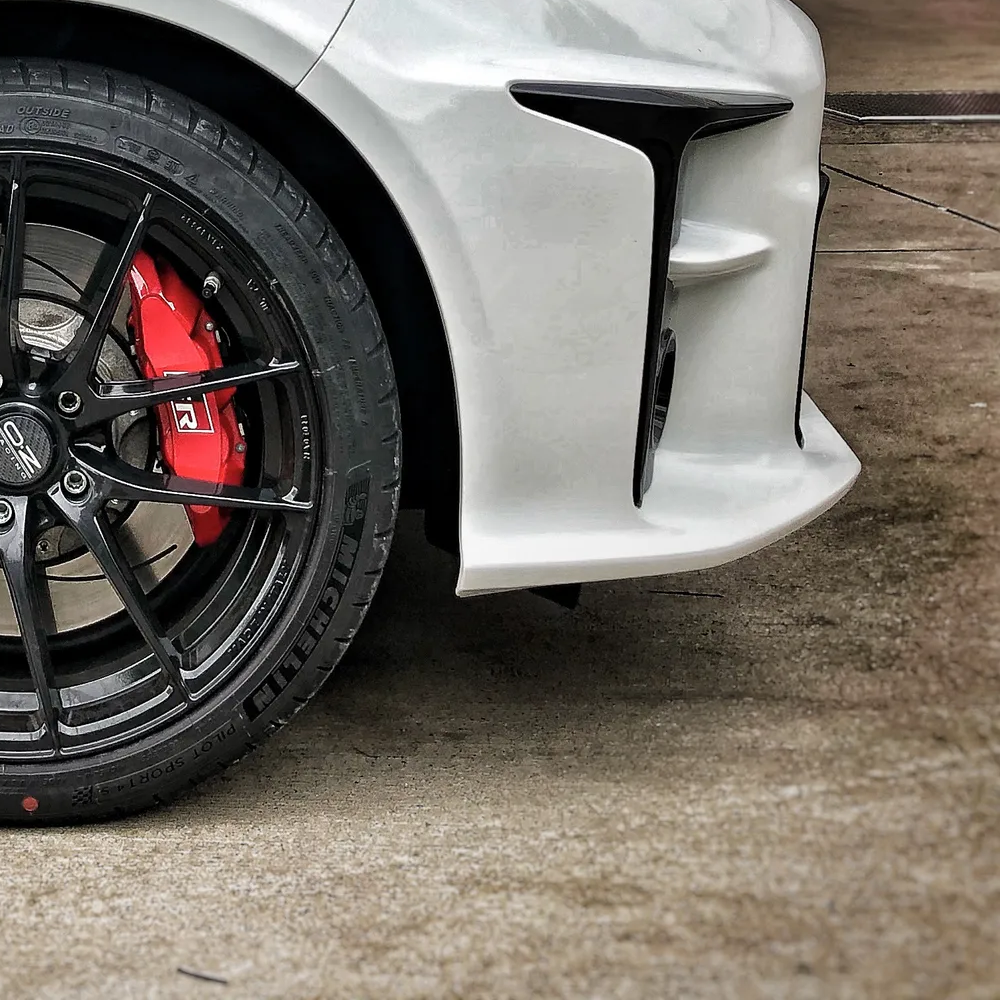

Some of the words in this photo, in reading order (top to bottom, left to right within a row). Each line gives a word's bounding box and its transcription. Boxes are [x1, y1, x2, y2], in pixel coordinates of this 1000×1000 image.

[16, 105, 70, 119] OUTSIDE
[252, 533, 360, 712] MICHELIN
[192, 722, 237, 760] PILOT
[130, 756, 185, 789] SPORT
